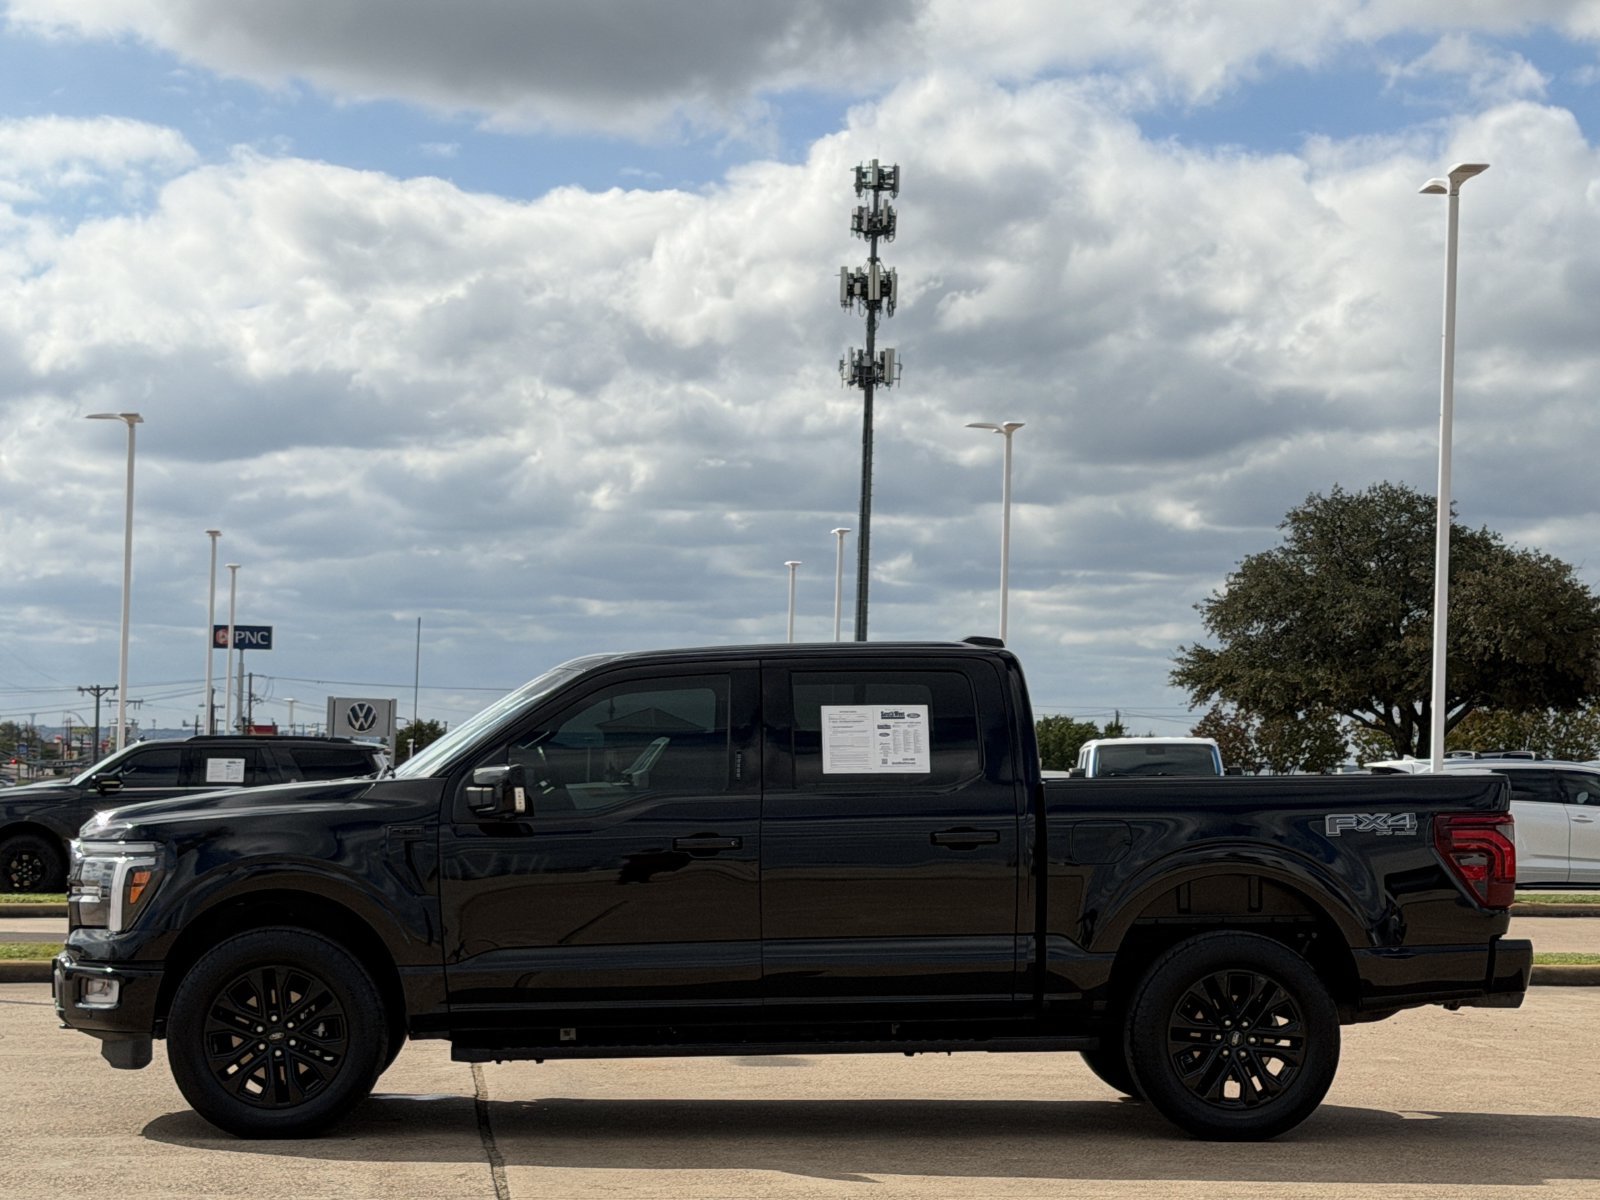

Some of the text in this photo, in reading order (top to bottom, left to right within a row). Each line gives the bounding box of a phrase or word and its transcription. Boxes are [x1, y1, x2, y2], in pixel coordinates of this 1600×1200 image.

[235, 631, 269, 645] PNC
[348, 702, 377, 732] VW
[1325, 813, 1417, 836] FX4
